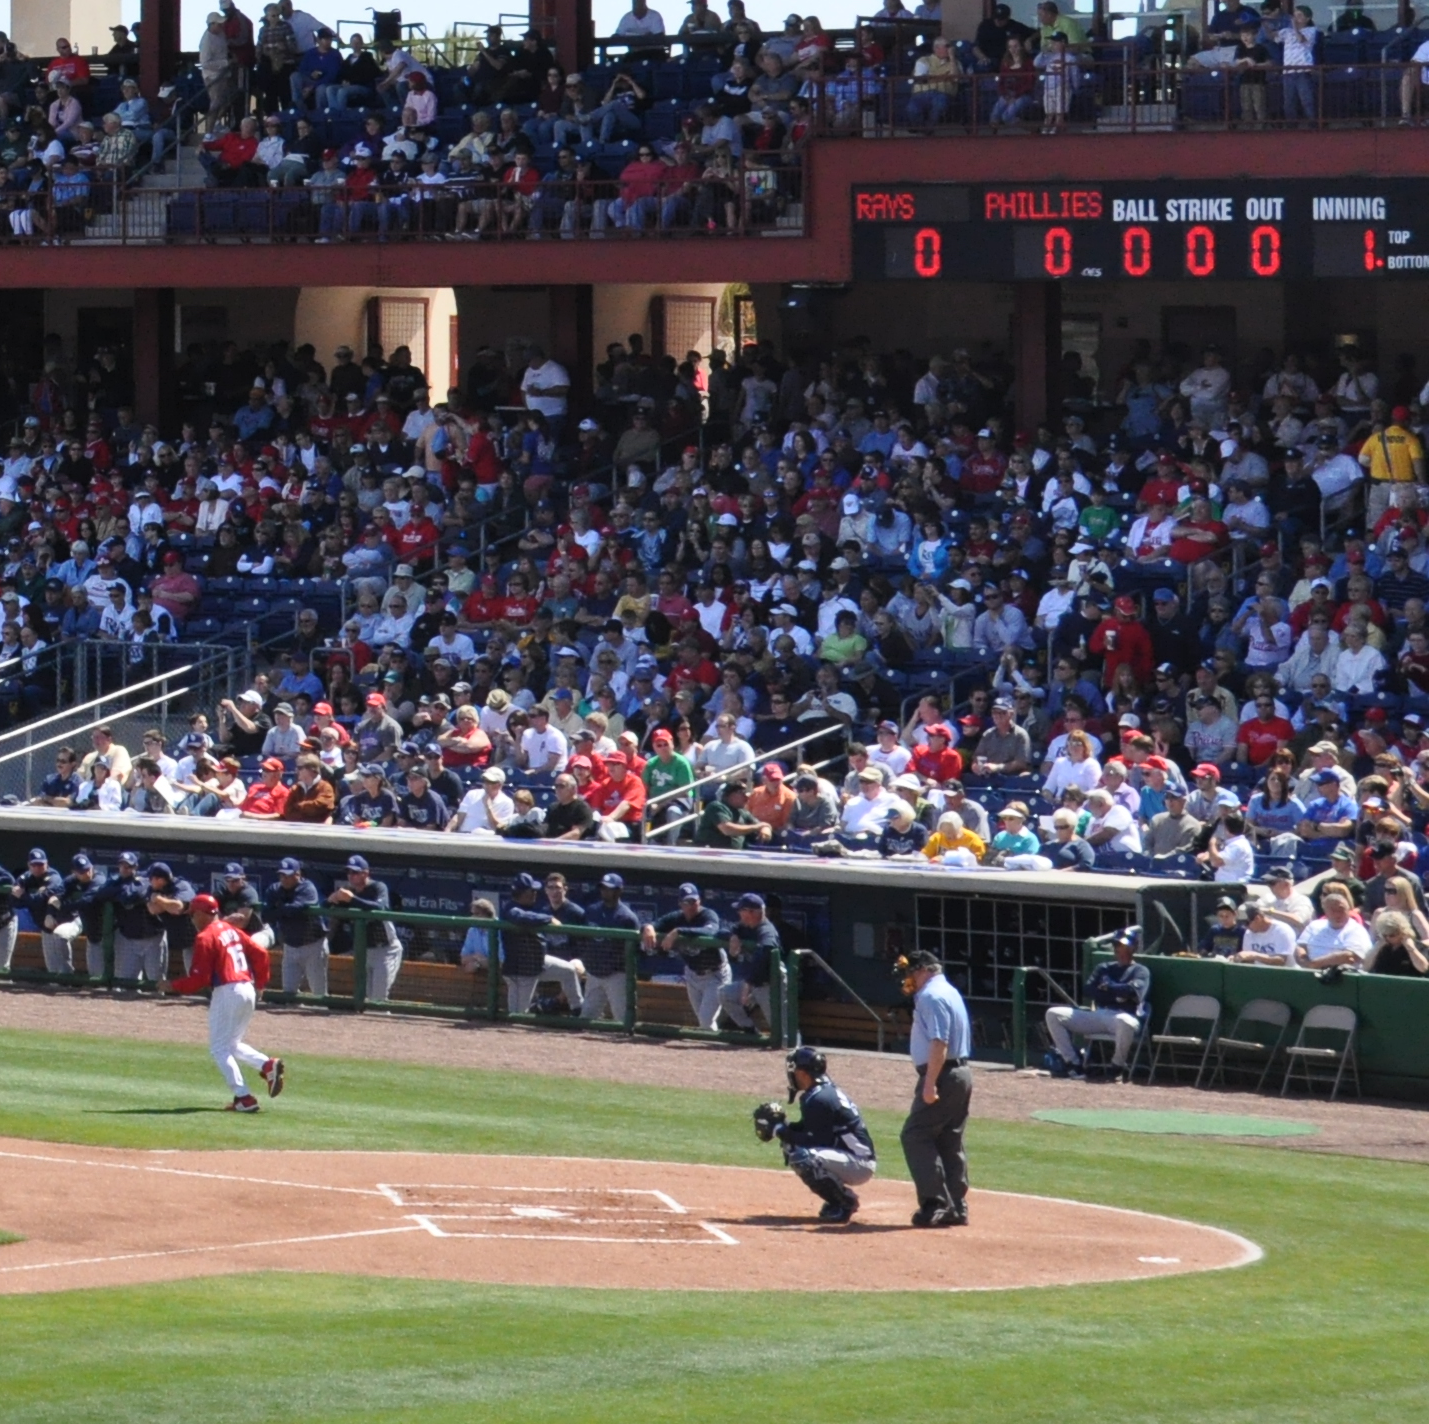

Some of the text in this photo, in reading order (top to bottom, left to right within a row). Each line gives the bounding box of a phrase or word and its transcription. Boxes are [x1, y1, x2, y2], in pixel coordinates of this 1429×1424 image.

[856, 193, 915, 220] RAYS
[985, 191, 1103, 220] PHILLIES
[1112, 197, 1387, 222] BALL STRIKE OUT INNING
[914, 228, 941, 277] 0
[1044, 227, 1072, 276] 0
[1123, 226, 1151, 276] 0
[1186, 226, 1215, 276] 0
[1251, 226, 1280, 276] 0
[1388, 230, 1411, 244] TOP
[419, 897, 437, 909] Era
